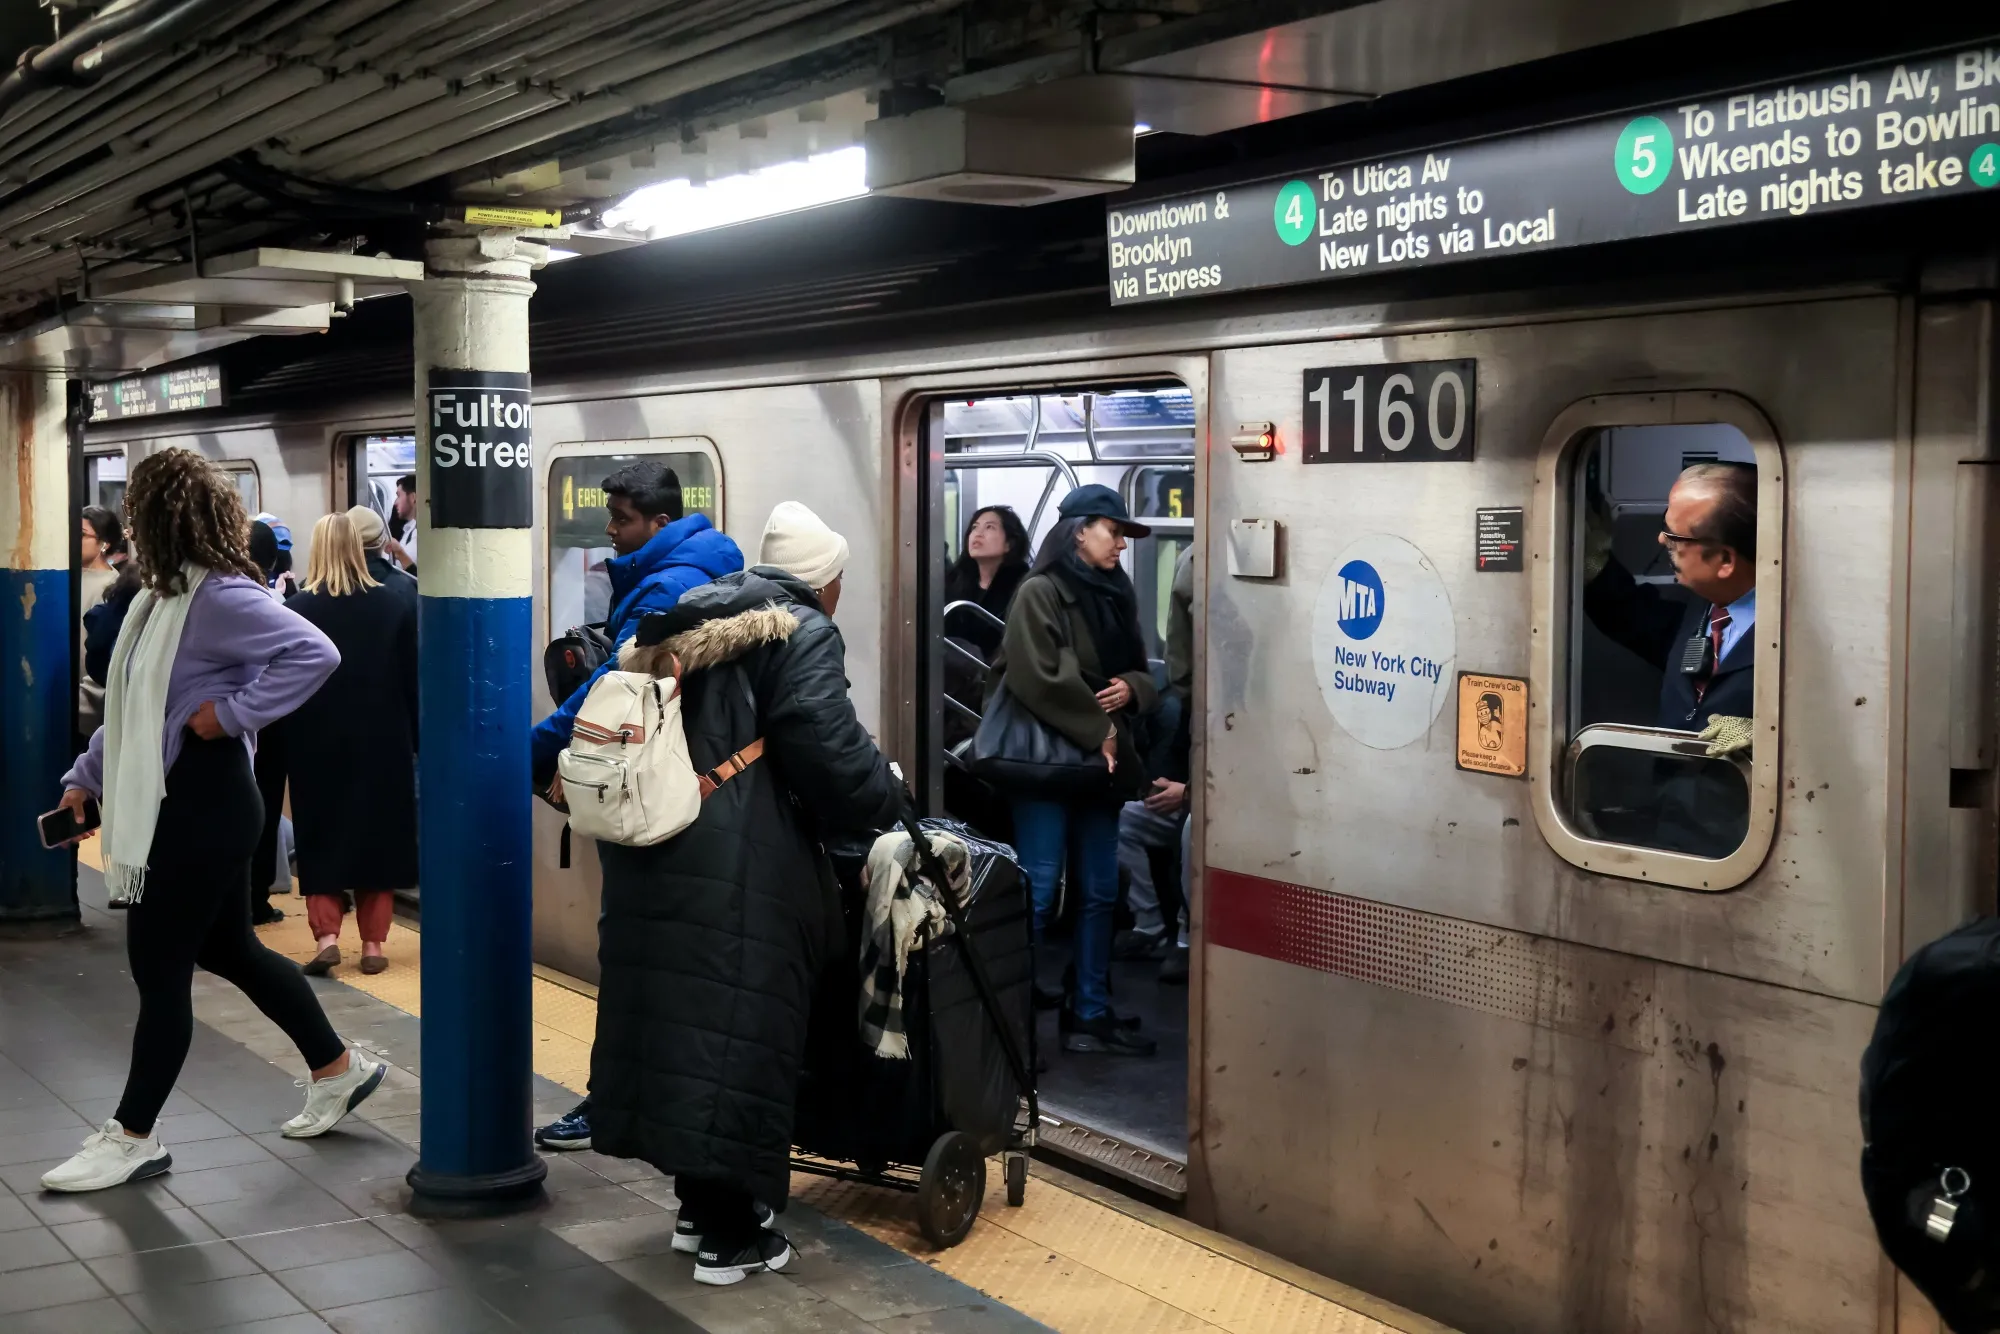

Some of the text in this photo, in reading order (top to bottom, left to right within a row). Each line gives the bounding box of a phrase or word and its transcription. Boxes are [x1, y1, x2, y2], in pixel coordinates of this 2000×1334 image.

[1678, 104, 1714, 139] To
[1728, 74, 1870, 132] Flatbush
[1886, 65, 1940, 104] Av,
[1631, 135, 1656, 179] 5
[1678, 97, 2000, 181] Wkends to Bowlin
[1319, 153, 1451, 201] To Utica Av
[1678, 152, 1995, 223] Late nights take 4
[1110, 192, 1230, 238] Downtown &
[1285, 195, 1303, 229] 4
[1319, 187, 1484, 237] Late nights to
[1111, 234, 1192, 269] Brooklyn
[1320, 210, 1556, 271] New Lots via Local
[1113, 264, 1221, 298] via Express
[434, 394, 532, 429] Fulton
[1309, 371, 1465, 452] 1160
[563, 476, 573, 519] 4
[681, 487, 711, 508] RESS
[1169, 489, 1182, 518] 5
[1338, 576, 1376, 621] MTA
[1334, 670, 1396, 702] Subway
[1335, 646, 1443, 684] New York City
[1467, 678, 1520, 692] Train Crew's Cab
